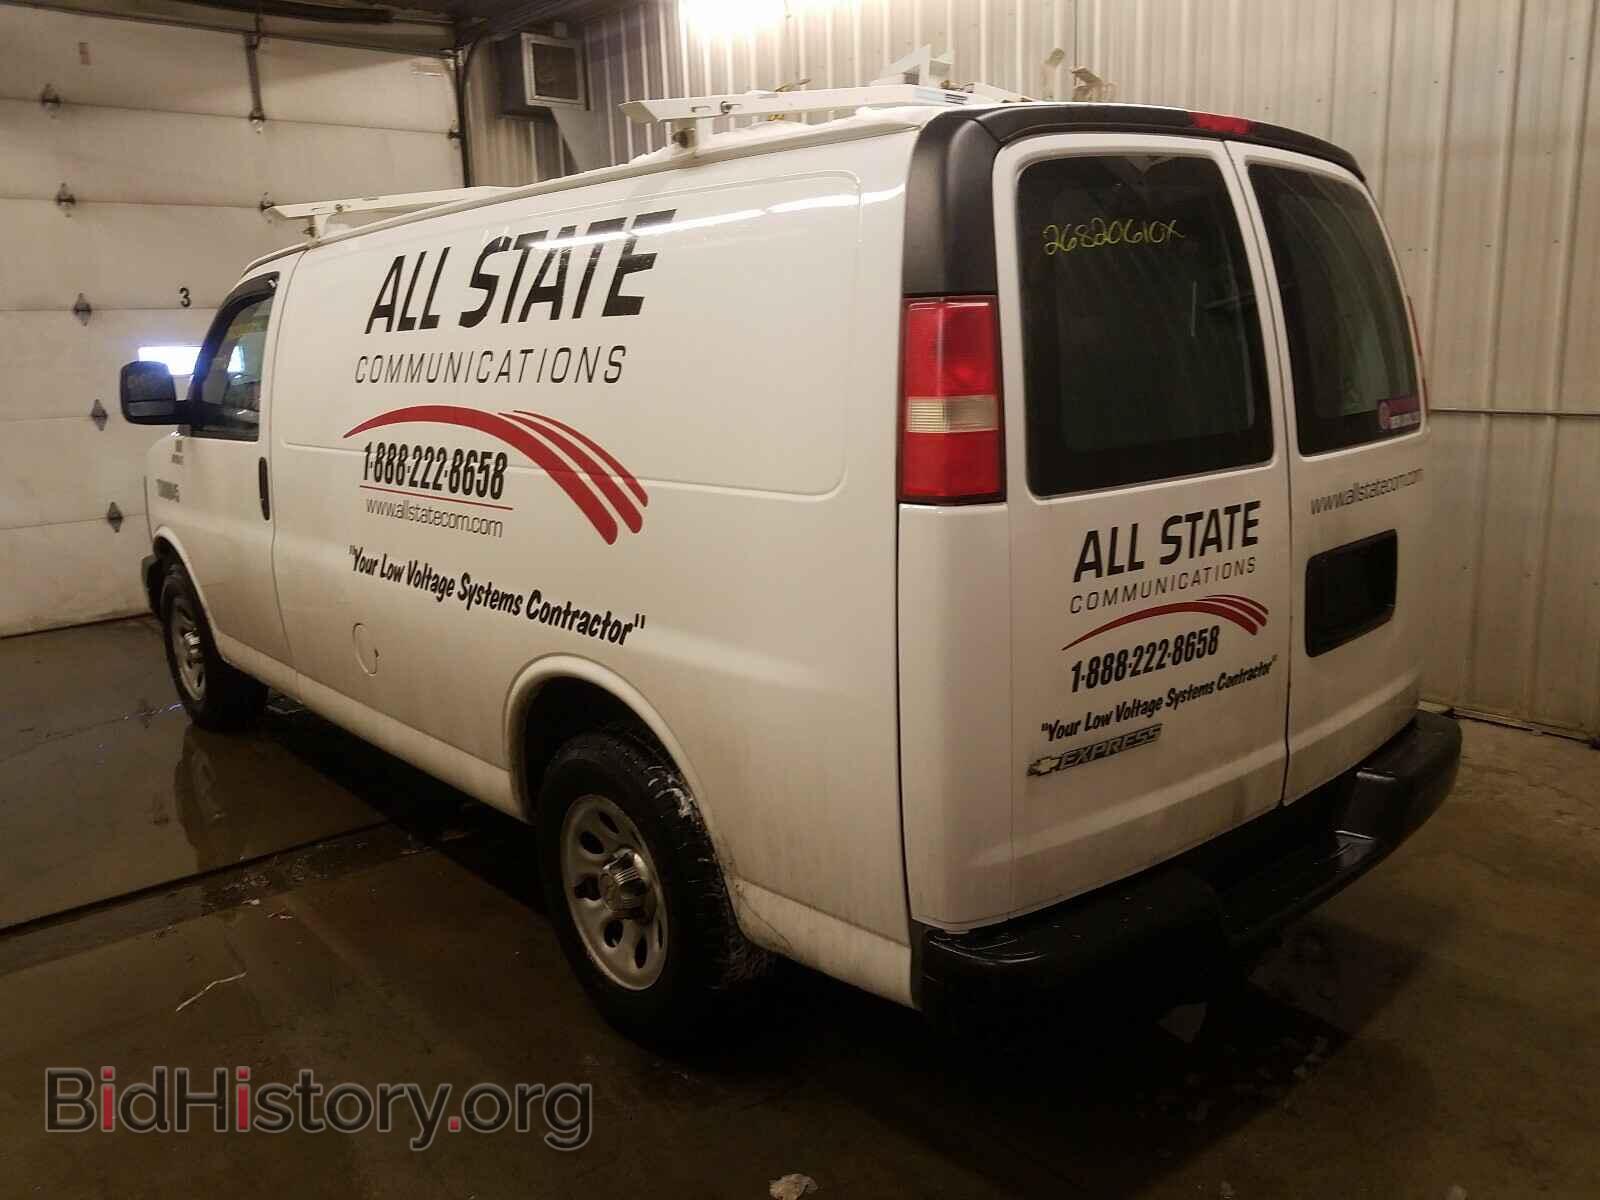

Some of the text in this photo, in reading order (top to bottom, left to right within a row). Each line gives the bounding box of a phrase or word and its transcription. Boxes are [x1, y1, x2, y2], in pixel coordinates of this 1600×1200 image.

[180, 287, 191, 308] 3
[364, 209, 677, 334] ALL STATE
[355, 345, 627, 384] COMMUNICATIONS
[366, 497, 503, 538] www.allstatecom.com
[1073, 500, 1261, 583] ALL STATE
[349, 544, 646, 646] "Your Low Voltage Systems Contractor"
[1069, 556, 1257, 614] COMMUNICATIONS
[1041, 654, 1278, 742] "Your Low Voltage Systems Contractor"
[1059, 723, 1163, 770] EXPRESS
